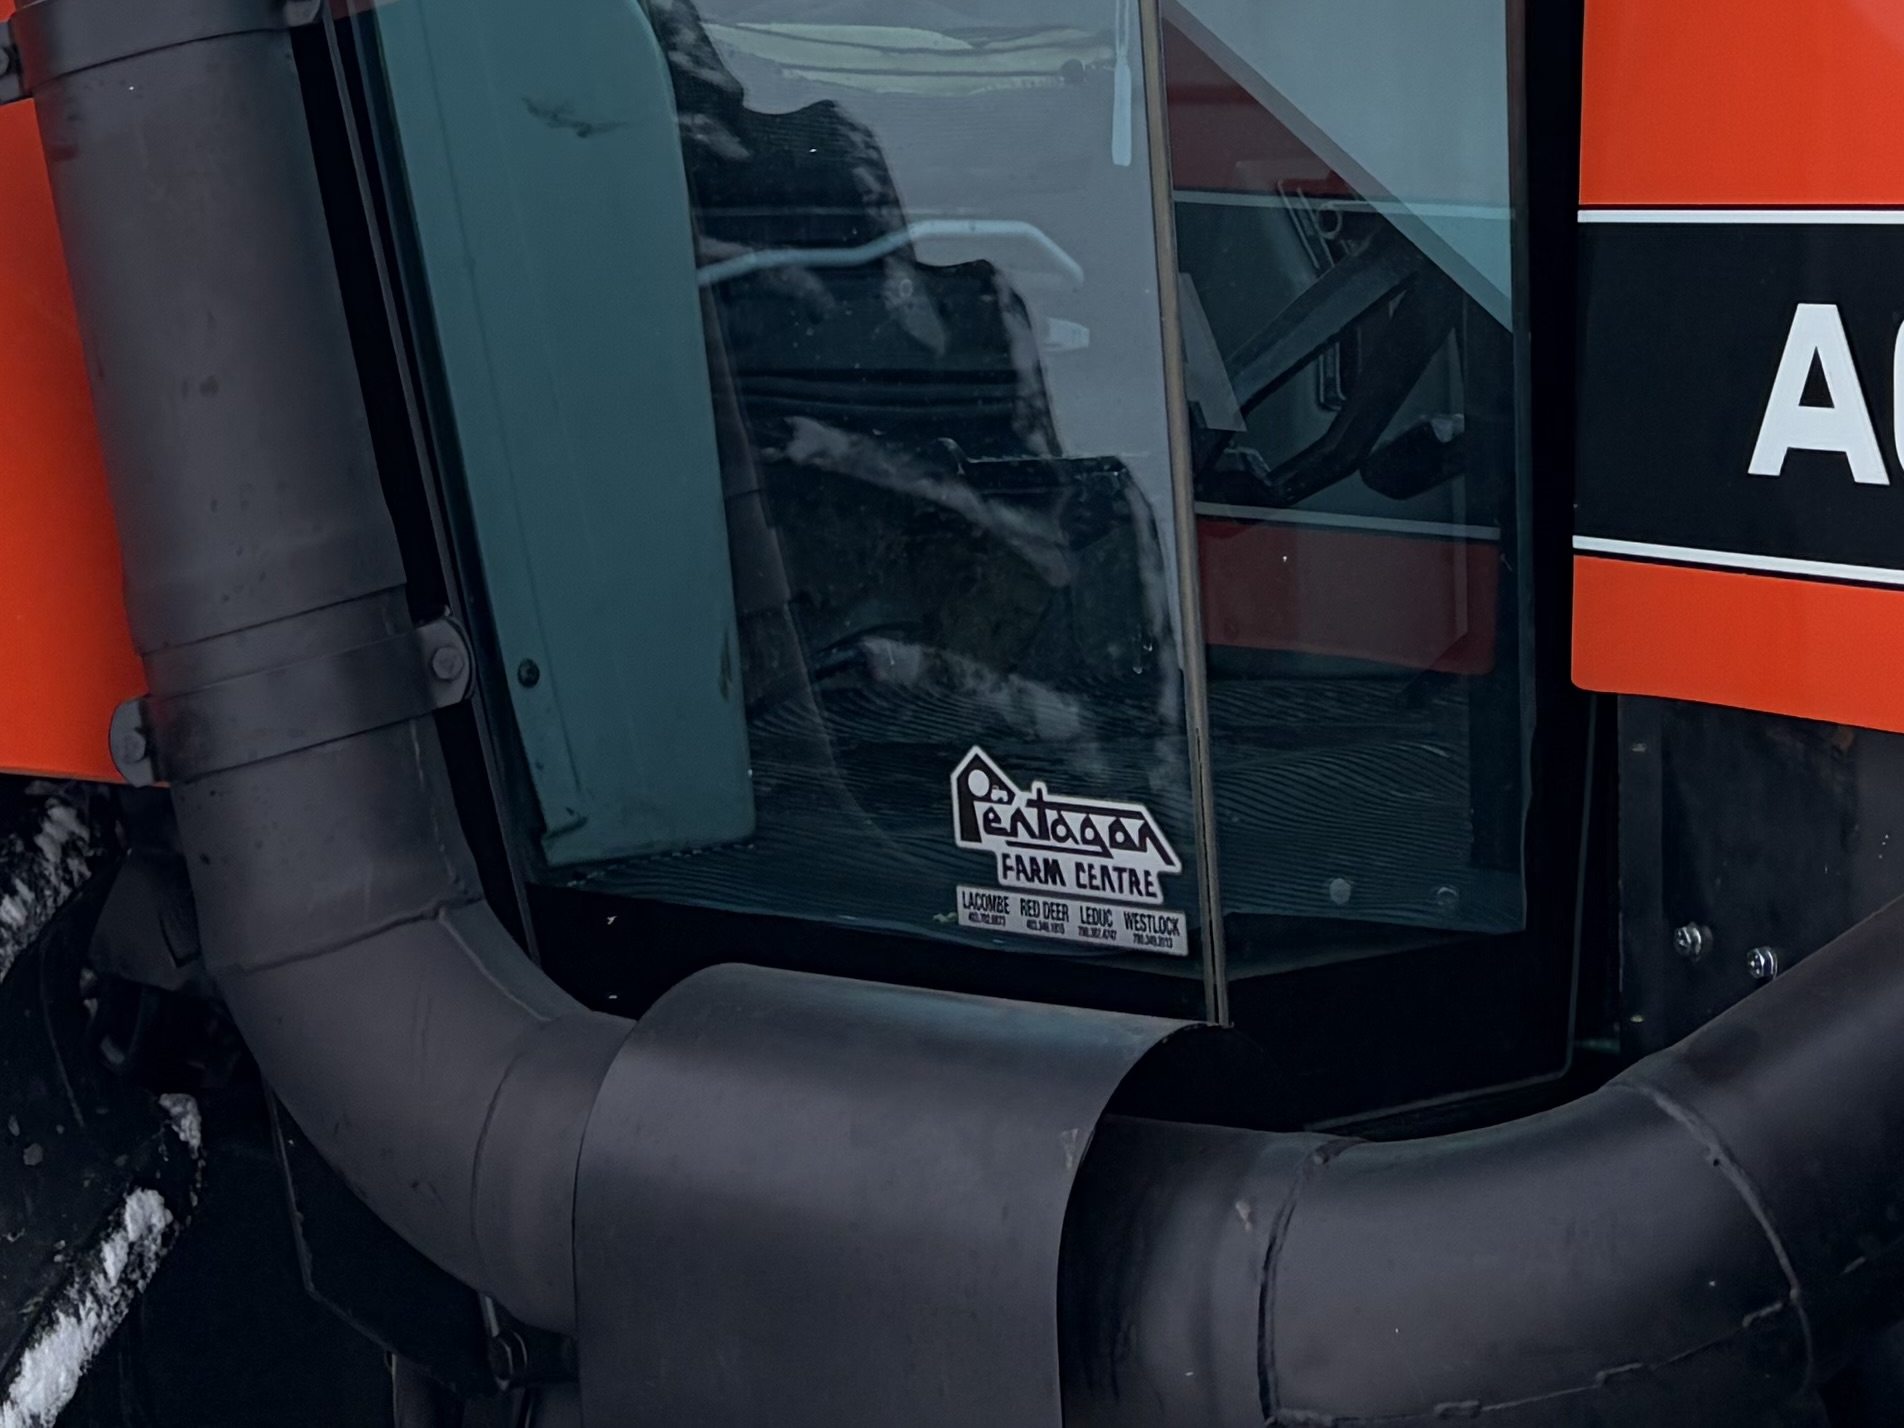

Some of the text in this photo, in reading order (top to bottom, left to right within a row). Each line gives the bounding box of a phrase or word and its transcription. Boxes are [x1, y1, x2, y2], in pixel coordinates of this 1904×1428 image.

[1001, 853, 1158, 898] FARM CENTRE
[962, 891, 1010, 915] LACOMBE
[1020, 897, 1041, 919] RED
[1042, 900, 1070, 924] DEER
[1079, 906, 1114, 928] LEDUC
[1123, 911, 1181, 937] WESTLOCK
